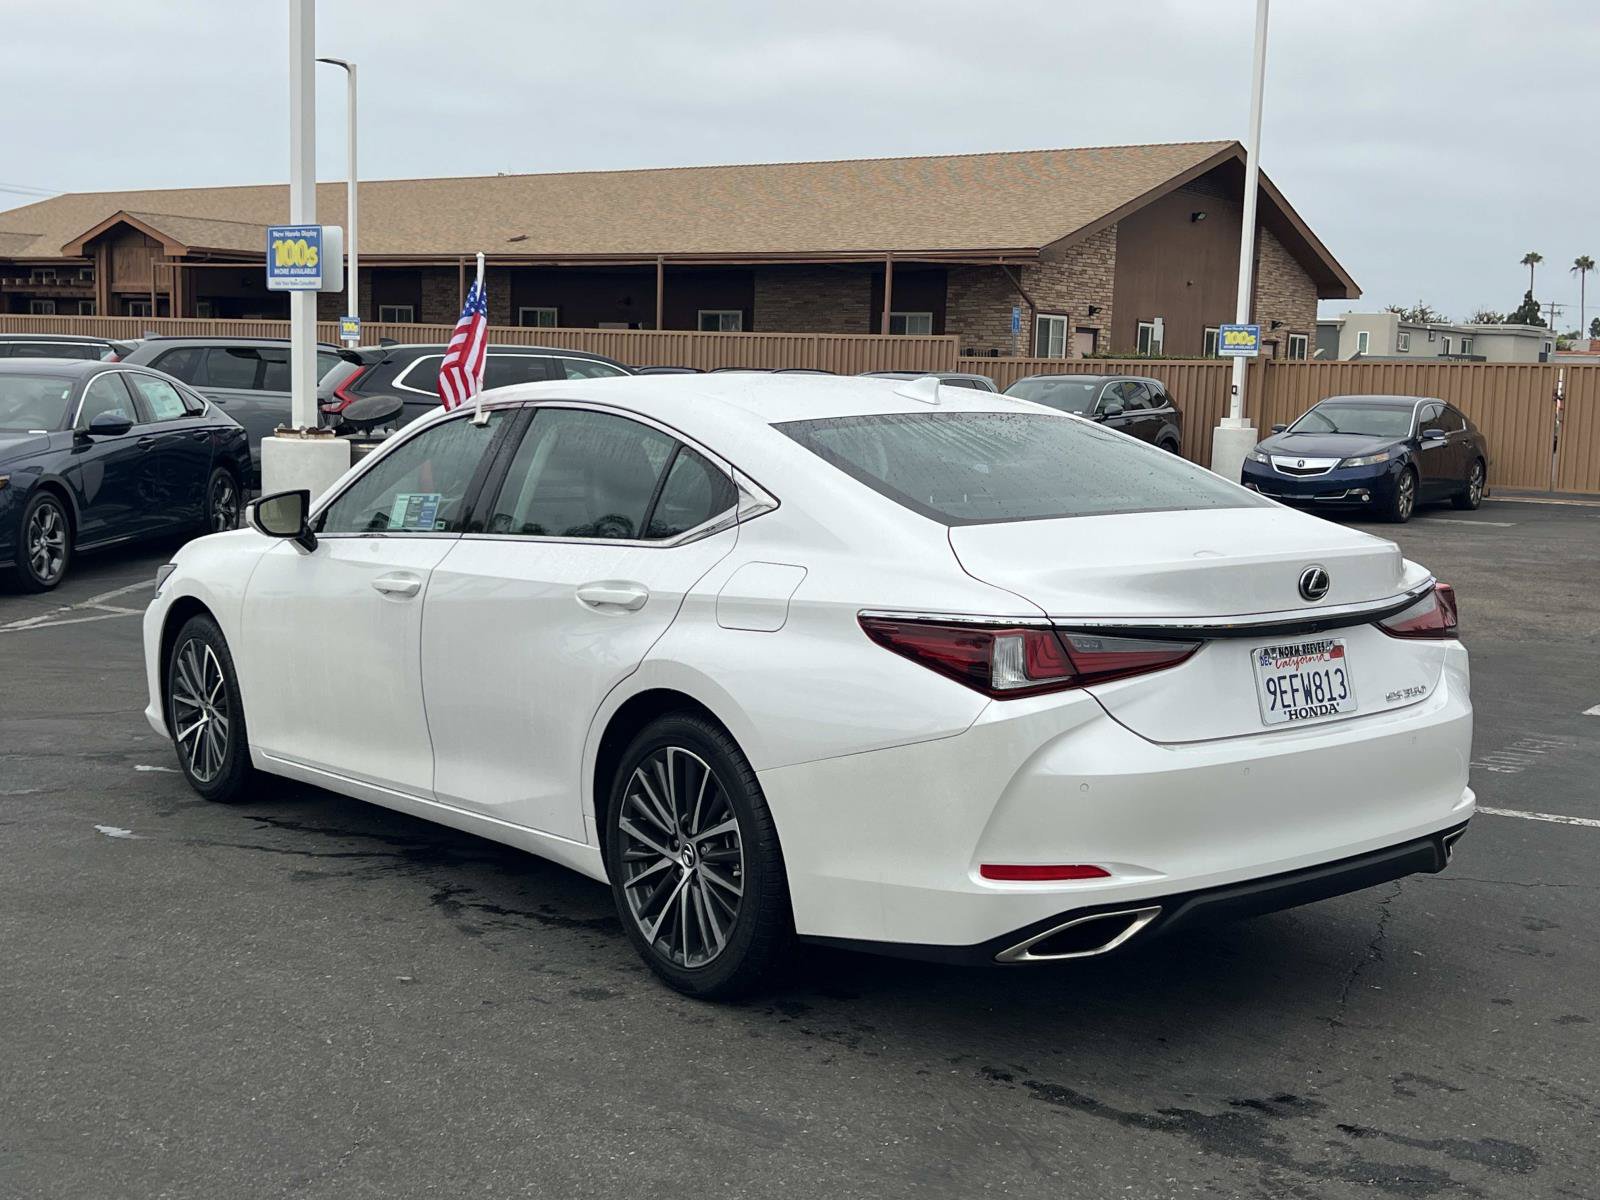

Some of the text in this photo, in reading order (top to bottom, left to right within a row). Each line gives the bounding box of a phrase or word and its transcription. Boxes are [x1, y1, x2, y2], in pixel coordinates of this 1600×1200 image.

[272, 239, 318, 267] 100s
[1223, 331, 1256, 345] 100s
[1278, 645, 1300, 658] NORM
[1302, 641, 1324, 654] REEVES
[1275, 653, 1325, 671] California
[1266, 668, 1347, 711] 9EFW813
